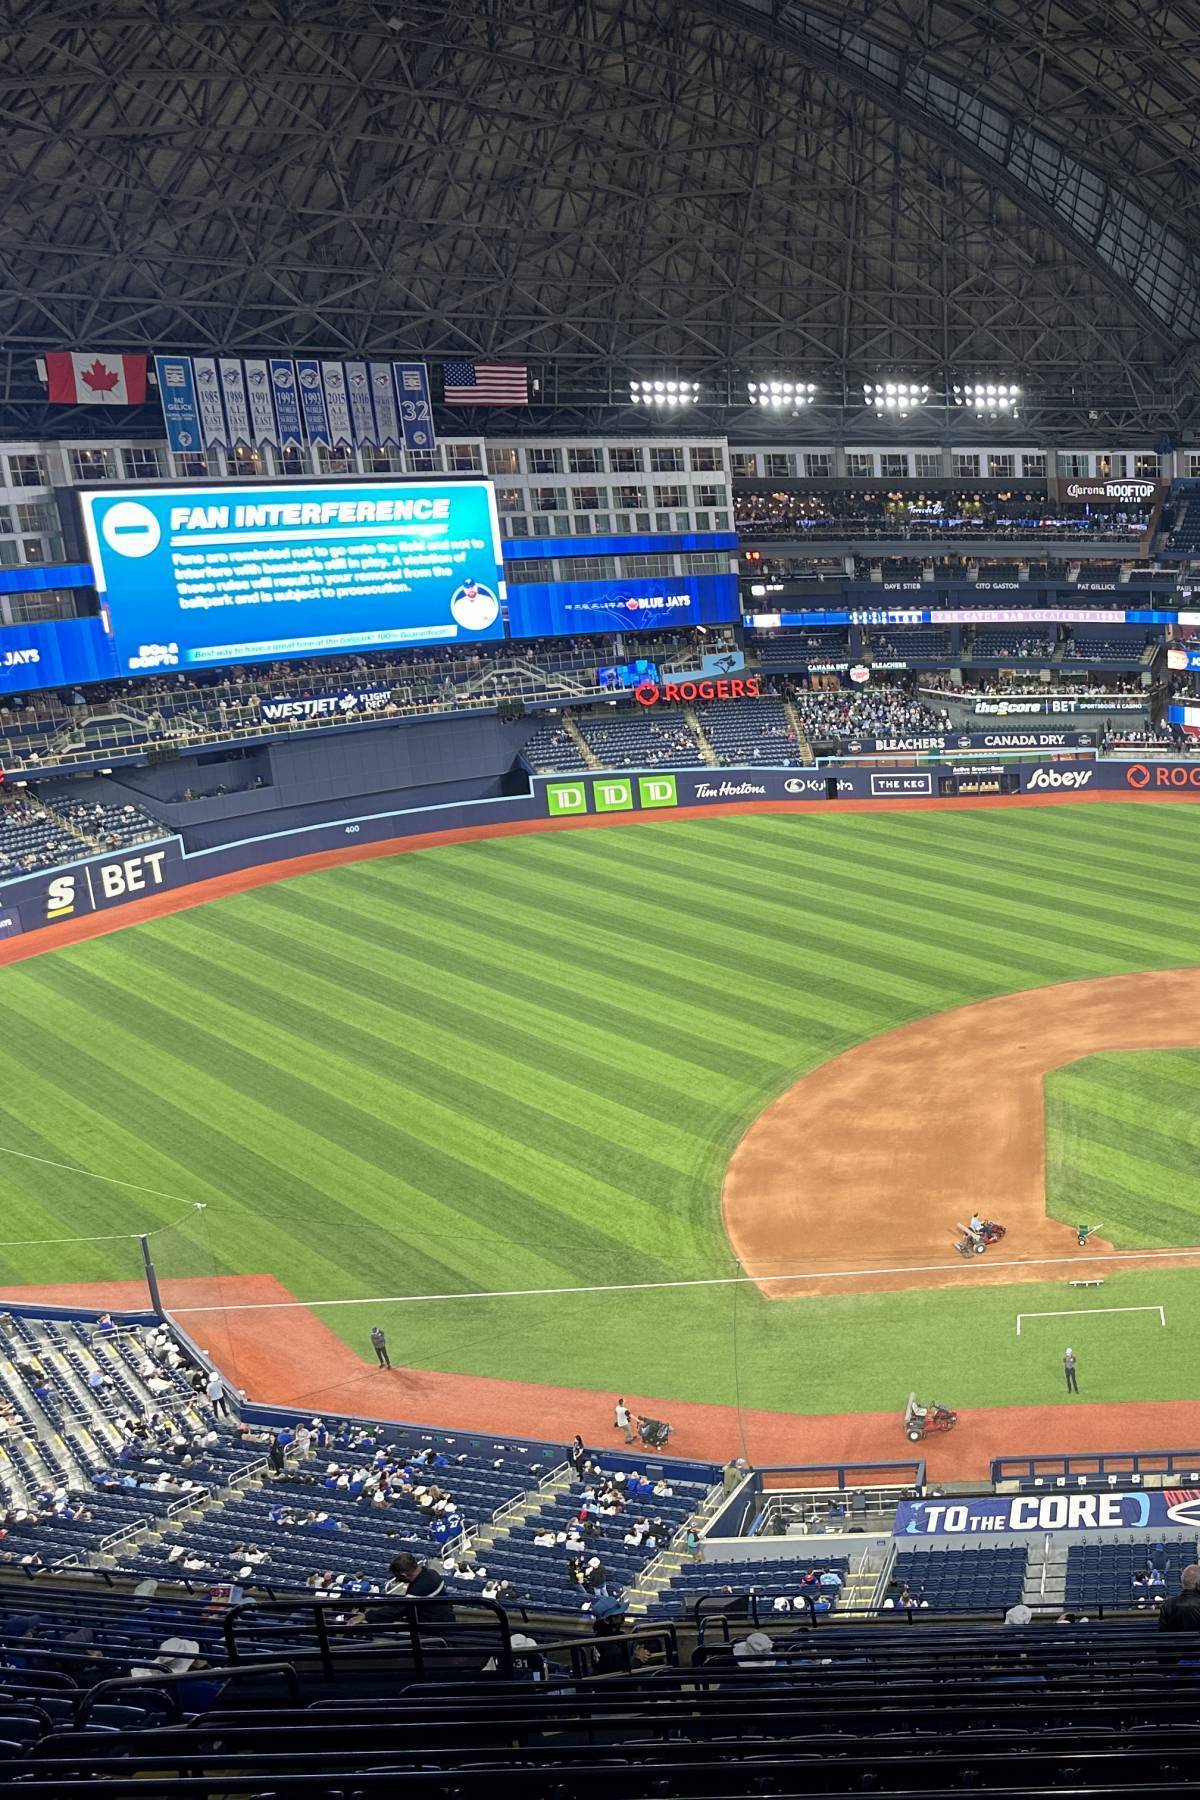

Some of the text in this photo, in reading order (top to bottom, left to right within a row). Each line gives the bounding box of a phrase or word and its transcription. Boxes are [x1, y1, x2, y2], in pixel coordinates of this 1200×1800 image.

[200, 391, 218, 403] 1985
[226, 391, 243, 404] 1989
[251, 392, 269, 404] 1991
[277, 392, 295, 405] 1992
[304, 393, 321, 405] 1993
[327, 393, 345, 404] 2015
[401, 401, 430, 421] 32
[205, 416, 222, 425] EAST
[229, 416, 246, 425] EAST
[255, 416, 272, 426] EAST
[1067, 484, 1154, 498] Corona ROOFTOP
[171, 499, 450, 530] FAN INTERFERENCE
[172, 553, 205, 565] Fans
[354, 569, 402, 582] removal
[403, 567, 432, 579] from
[432, 566, 453, 577] the
[1091, 583, 1116, 591] GILLICK
[639, 596, 664, 609] BLUE
[665, 595, 690, 607] JAYS
[938, 612, 959, 621] THE
[964, 612, 998, 621] CATCH
[1029, 612, 1073, 621] LOCATED
[3, 648, 40, 666] JAYS
[665, 678, 760, 700] ROGERS
[359, 691, 392, 703] FLIGHT
[262, 698, 338, 718] WESTJET
[975, 700, 1041, 713] theScore
[1052, 701, 1076, 712] BET
[876, 734, 1066, 750] BLEACHERS CANADA DRY.
[878, 780, 925, 788] THE KEG
[1026, 769, 1092, 789] Sobeys
[598, 785, 627, 805] TD
[643, 781, 673, 801] TD
[694, 780, 766, 798] Tim Hortons
[551, 788, 582, 808] TD
[345, 825, 360, 834] 400
[47, 852, 165, 909] S BET
[924, 1493, 1124, 1533] TO THE CORE
